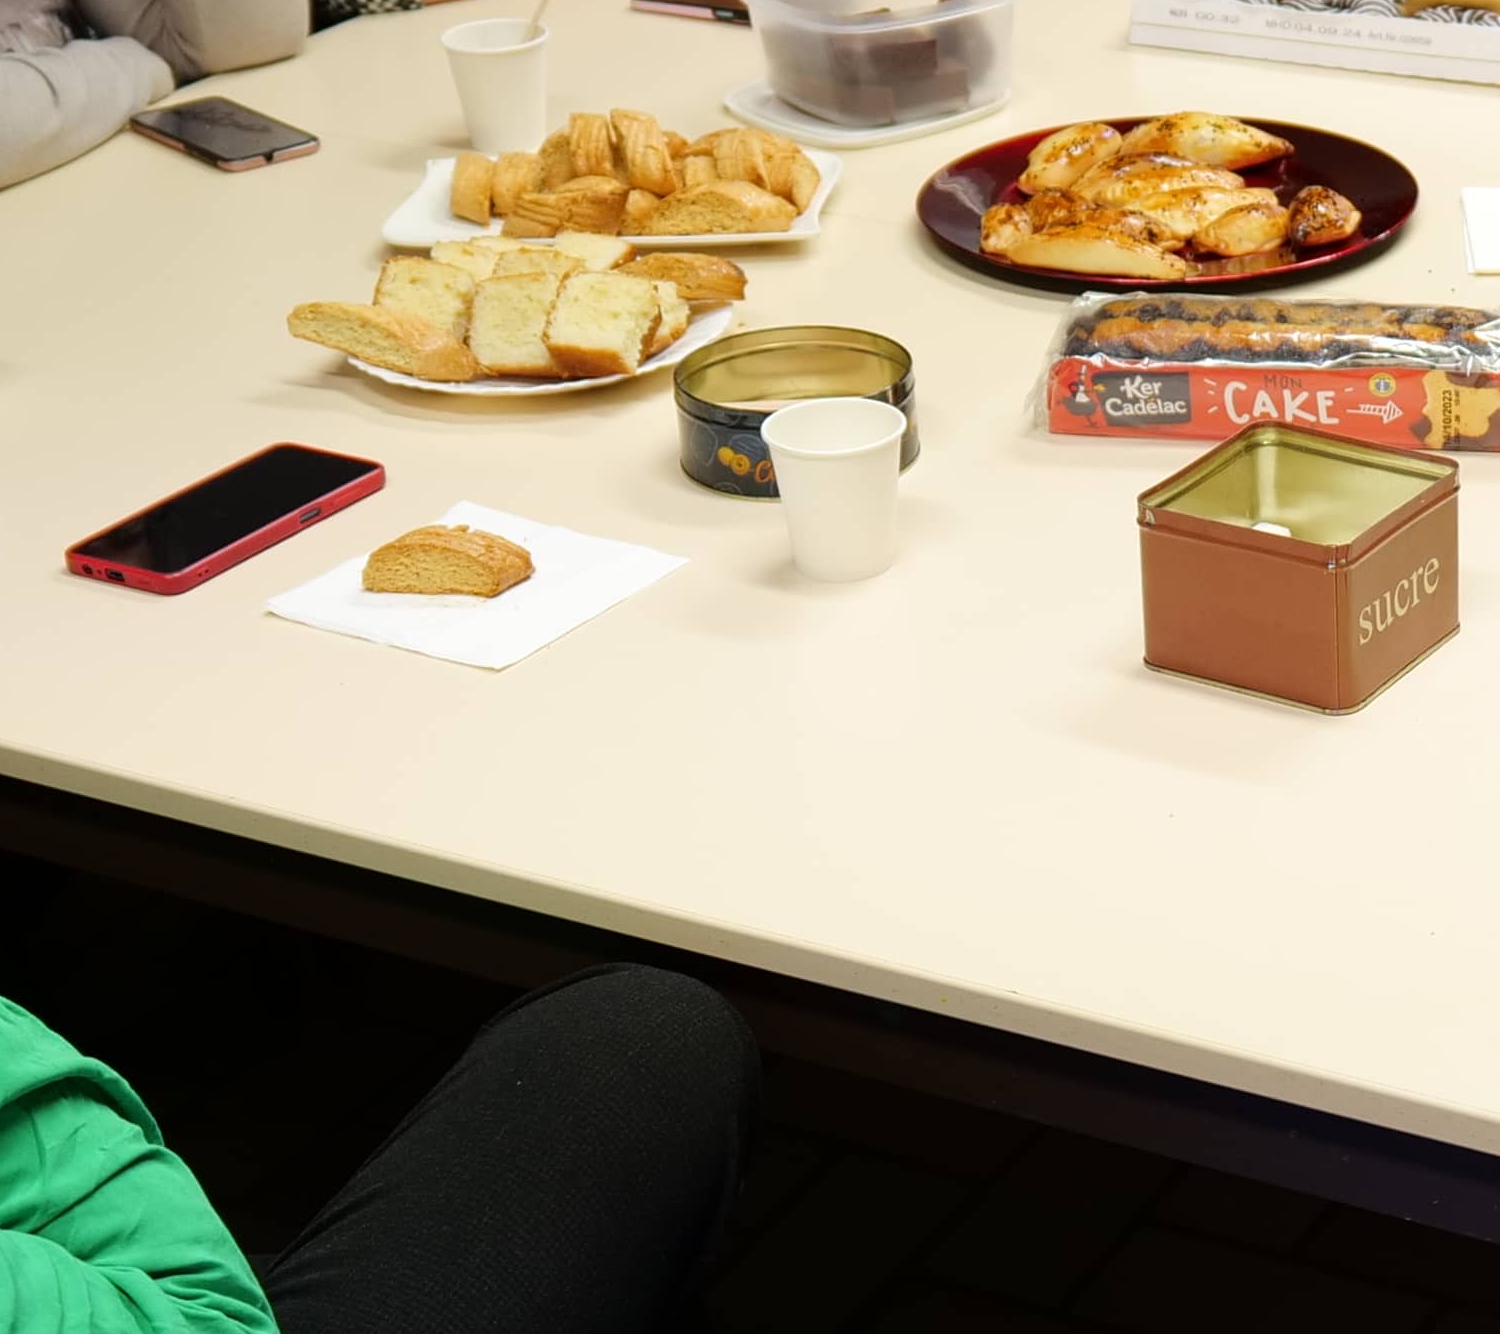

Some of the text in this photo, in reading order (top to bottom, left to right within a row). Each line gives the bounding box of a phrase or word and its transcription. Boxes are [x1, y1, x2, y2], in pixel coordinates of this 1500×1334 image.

[1120, 375, 1162, 398] Ker
[1224, 381, 1339, 424] CAKE
[1105, 396, 1187, 416] Cadélac
[1358, 557, 1440, 645] sucre
